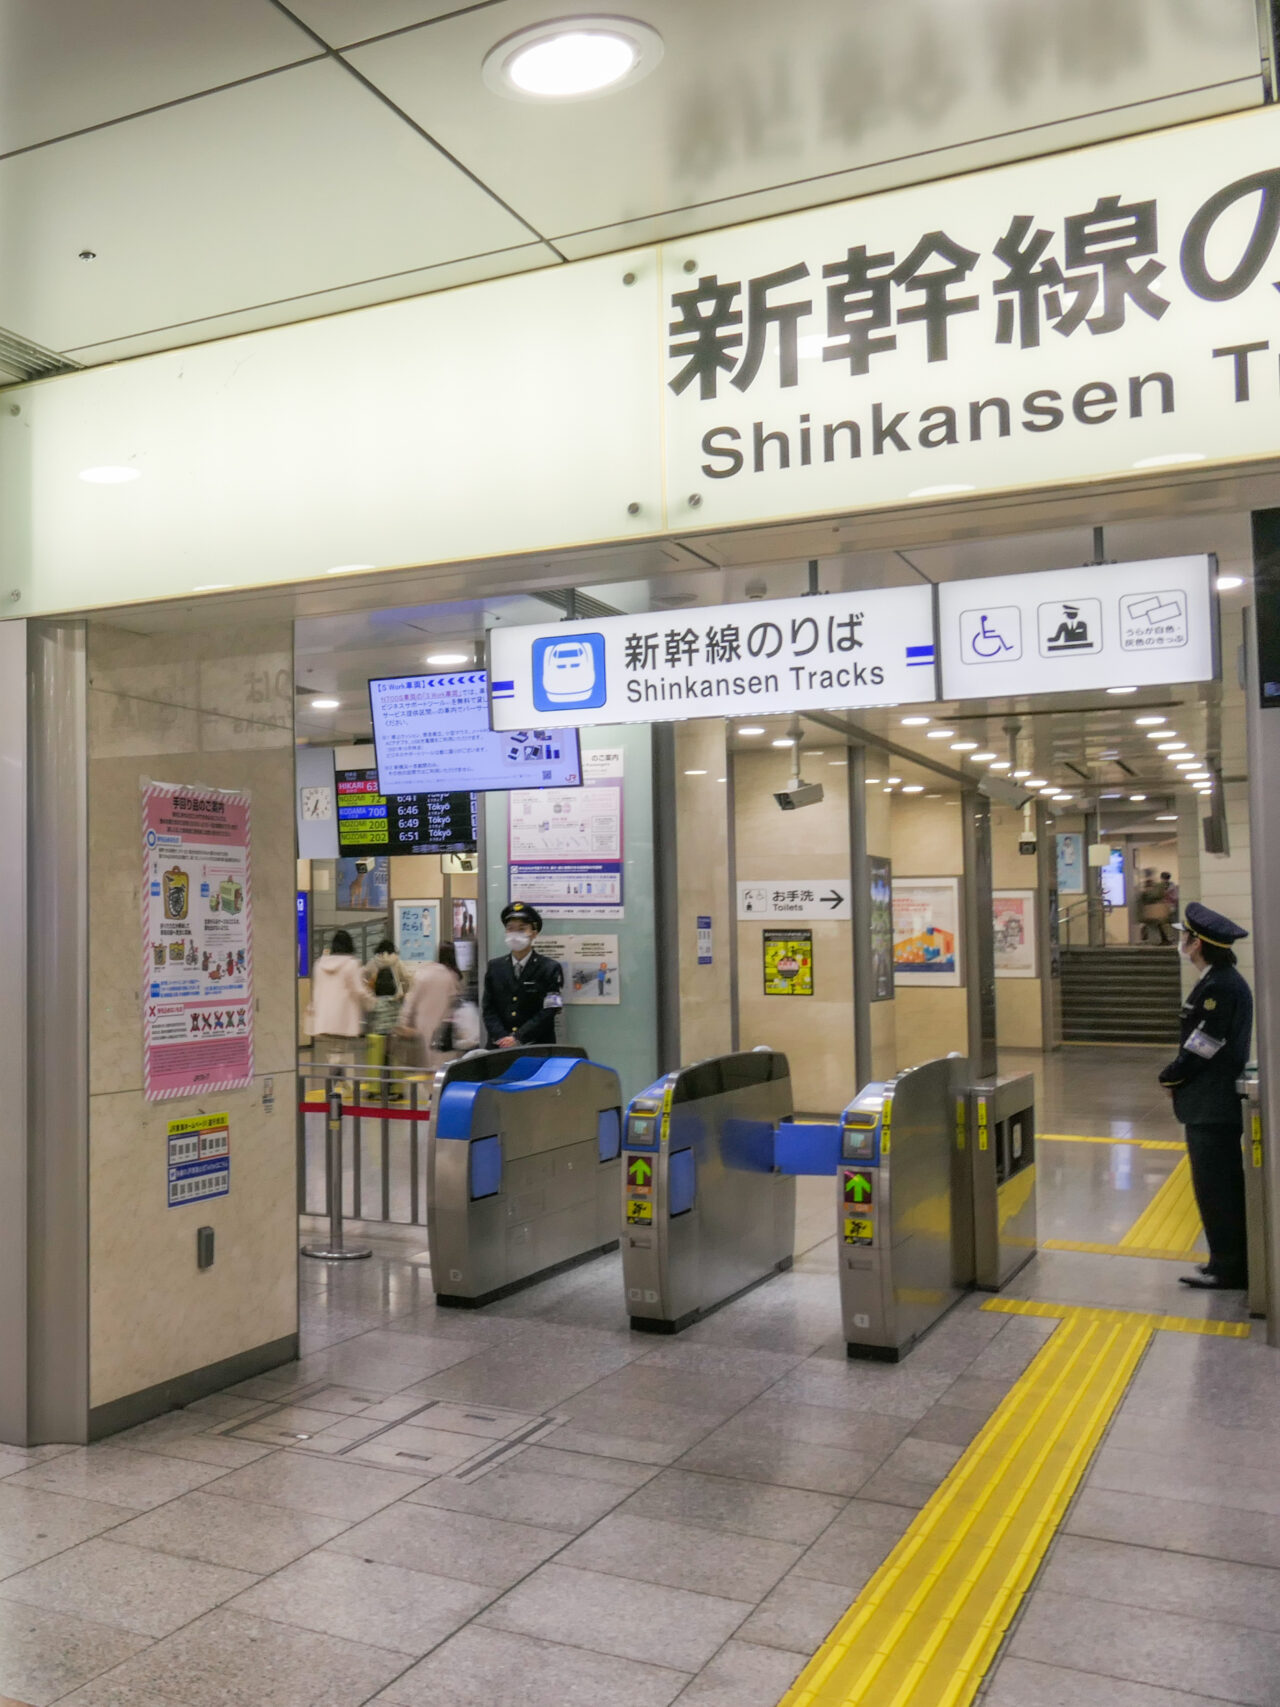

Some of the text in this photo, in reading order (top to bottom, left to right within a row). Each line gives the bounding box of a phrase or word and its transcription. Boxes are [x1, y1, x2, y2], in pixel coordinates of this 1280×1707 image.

[667, 168, 1280, 400] 新幹線の
[701, 340, 1280, 479] Shinkansen T
[625, 612, 864, 671] 新幹線のりば
[626, 661, 884, 703] Shinkansen Tracks
[368, 808, 386, 816] 700
[397, 805, 419, 815] 6:46
[369, 820, 386, 829] 200
[398, 818, 419, 828] 6:49
[370, 833, 386, 842] 202
[399, 832, 419, 841] 6:51
[771, 889, 814, 902] お手洗
[772, 903, 804, 912] Toilets
